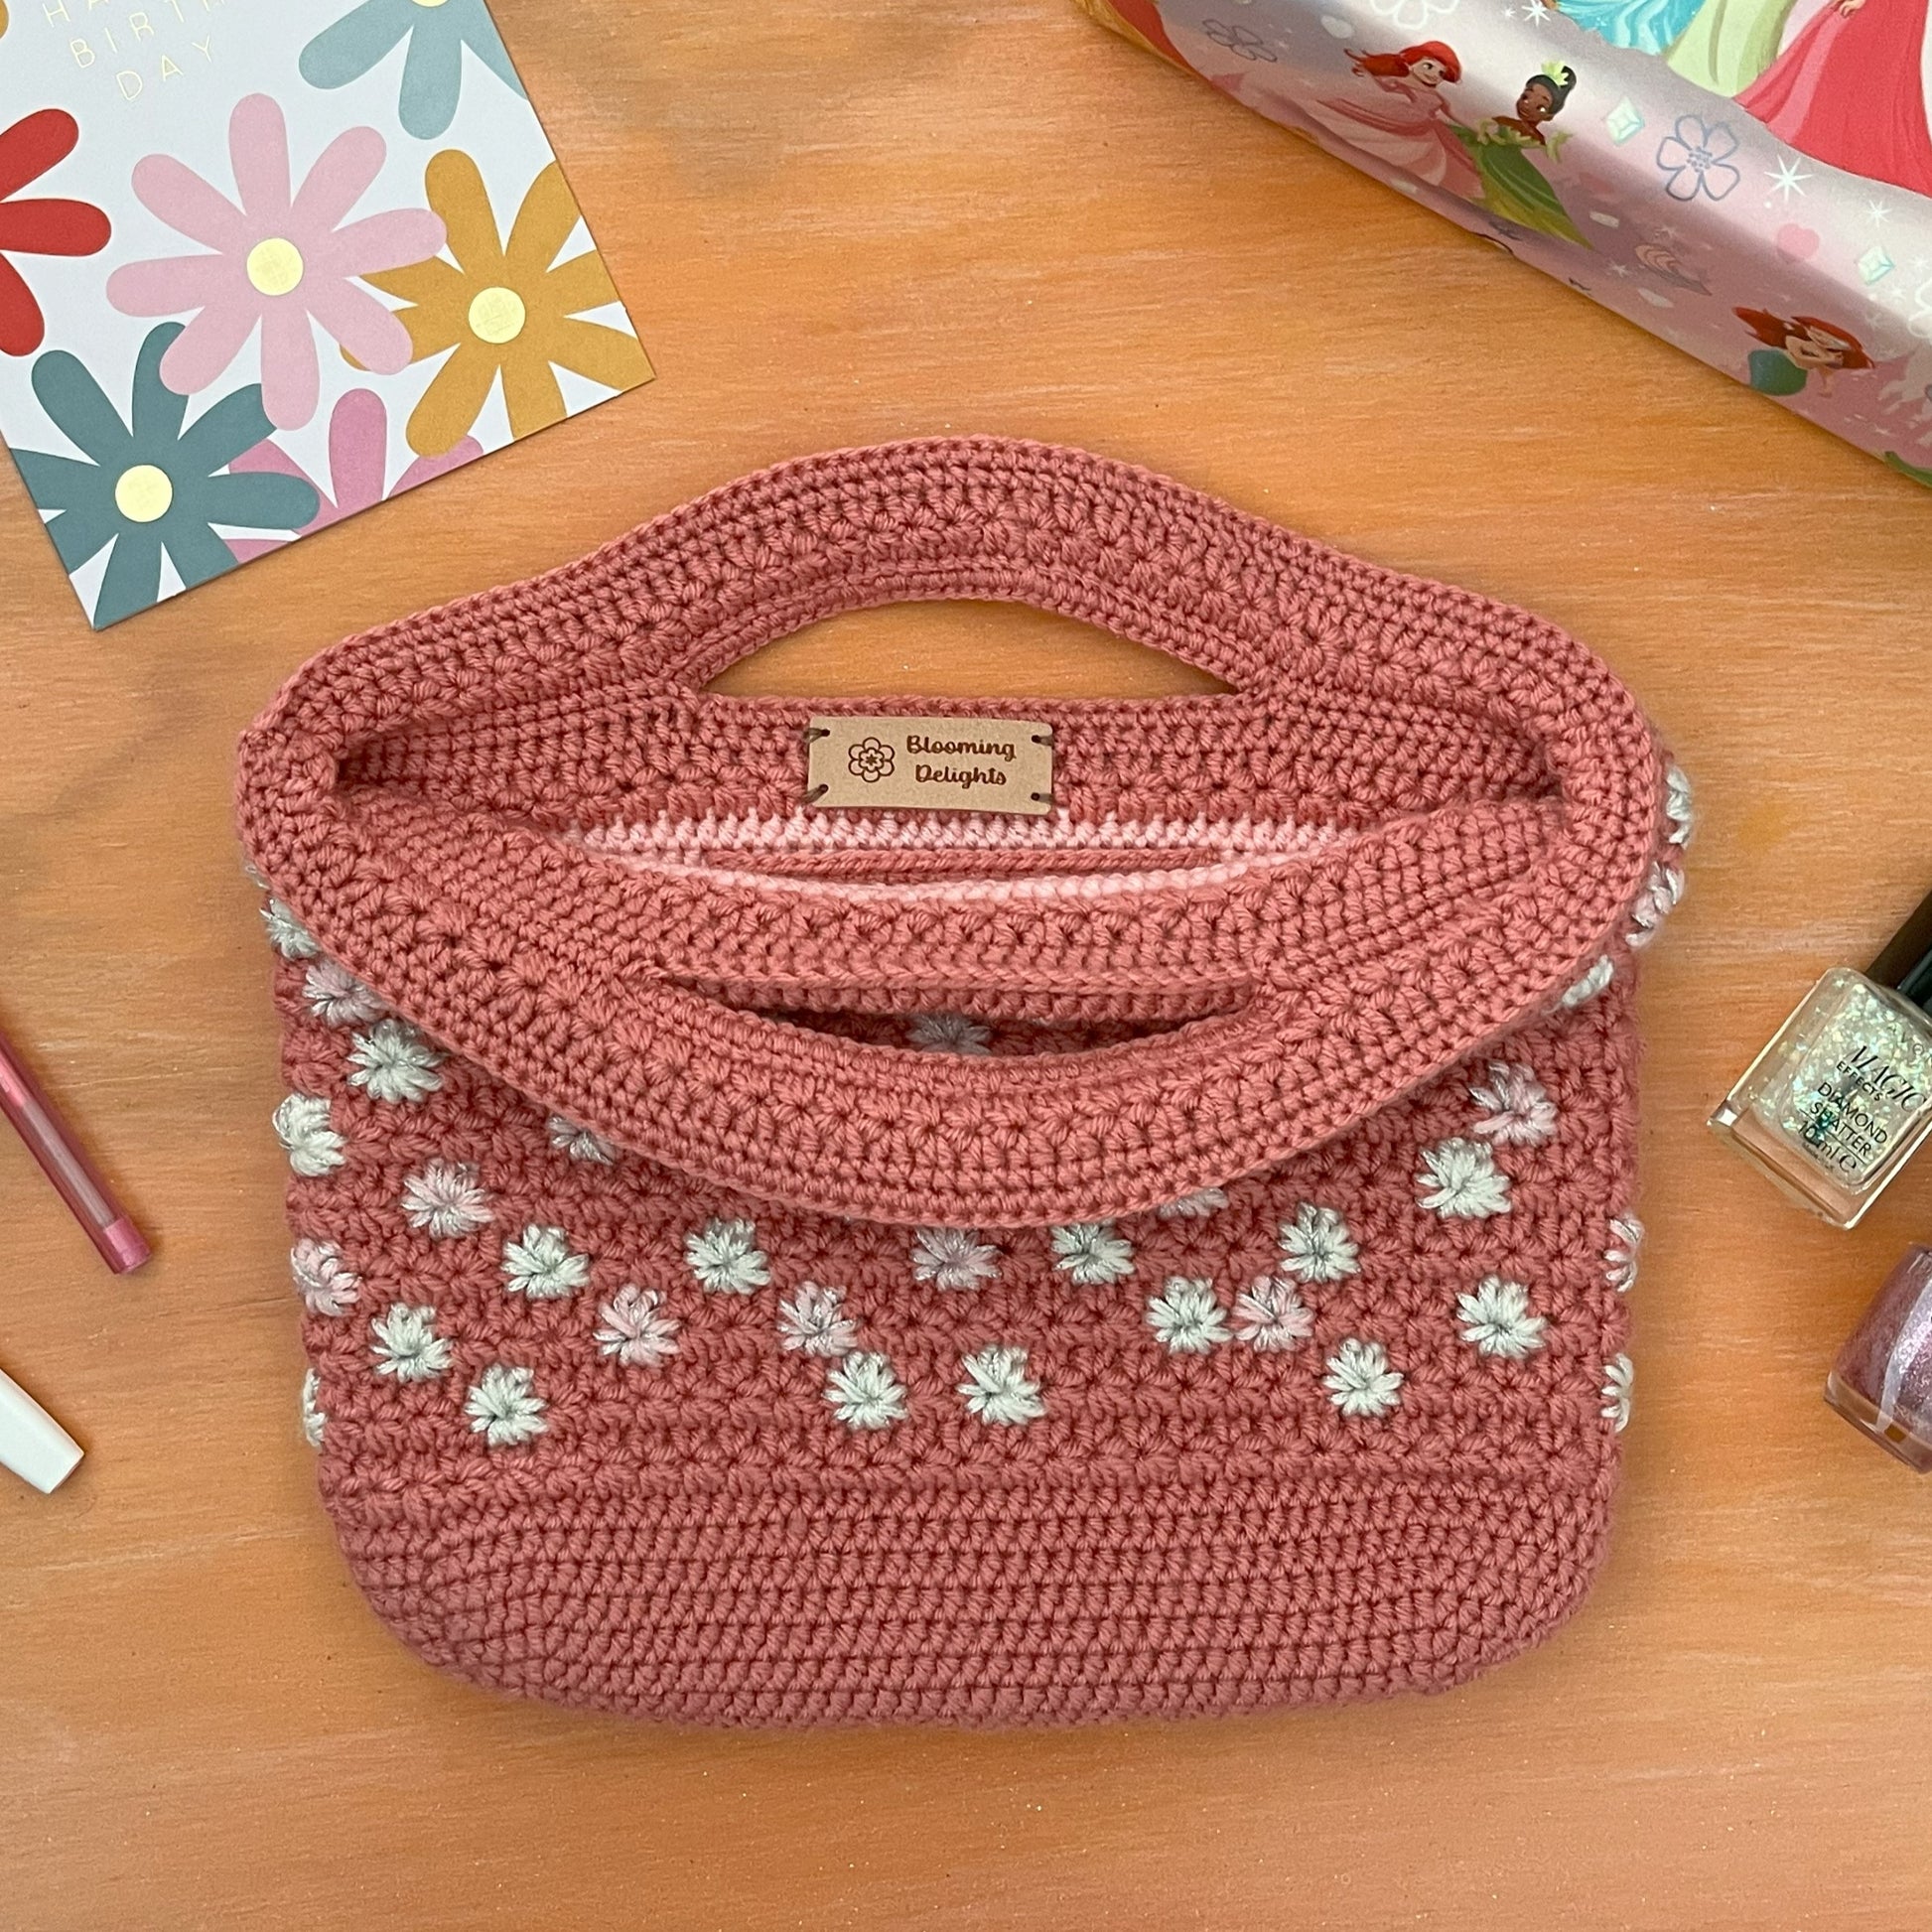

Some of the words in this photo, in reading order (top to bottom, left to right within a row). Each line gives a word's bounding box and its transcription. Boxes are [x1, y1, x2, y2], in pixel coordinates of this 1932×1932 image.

[115, 35, 212, 101] DAY
[906, 735, 1017, 762] Blooming
[915, 763, 1007, 789] Delights
[1836, 1060, 1883, 1102] EFFECTS
[1844, 1045, 1927, 1112] MAGIC
[1810, 1102, 1871, 1157] SHATTER
[1818, 1082, 1888, 1144] DIAMOND
